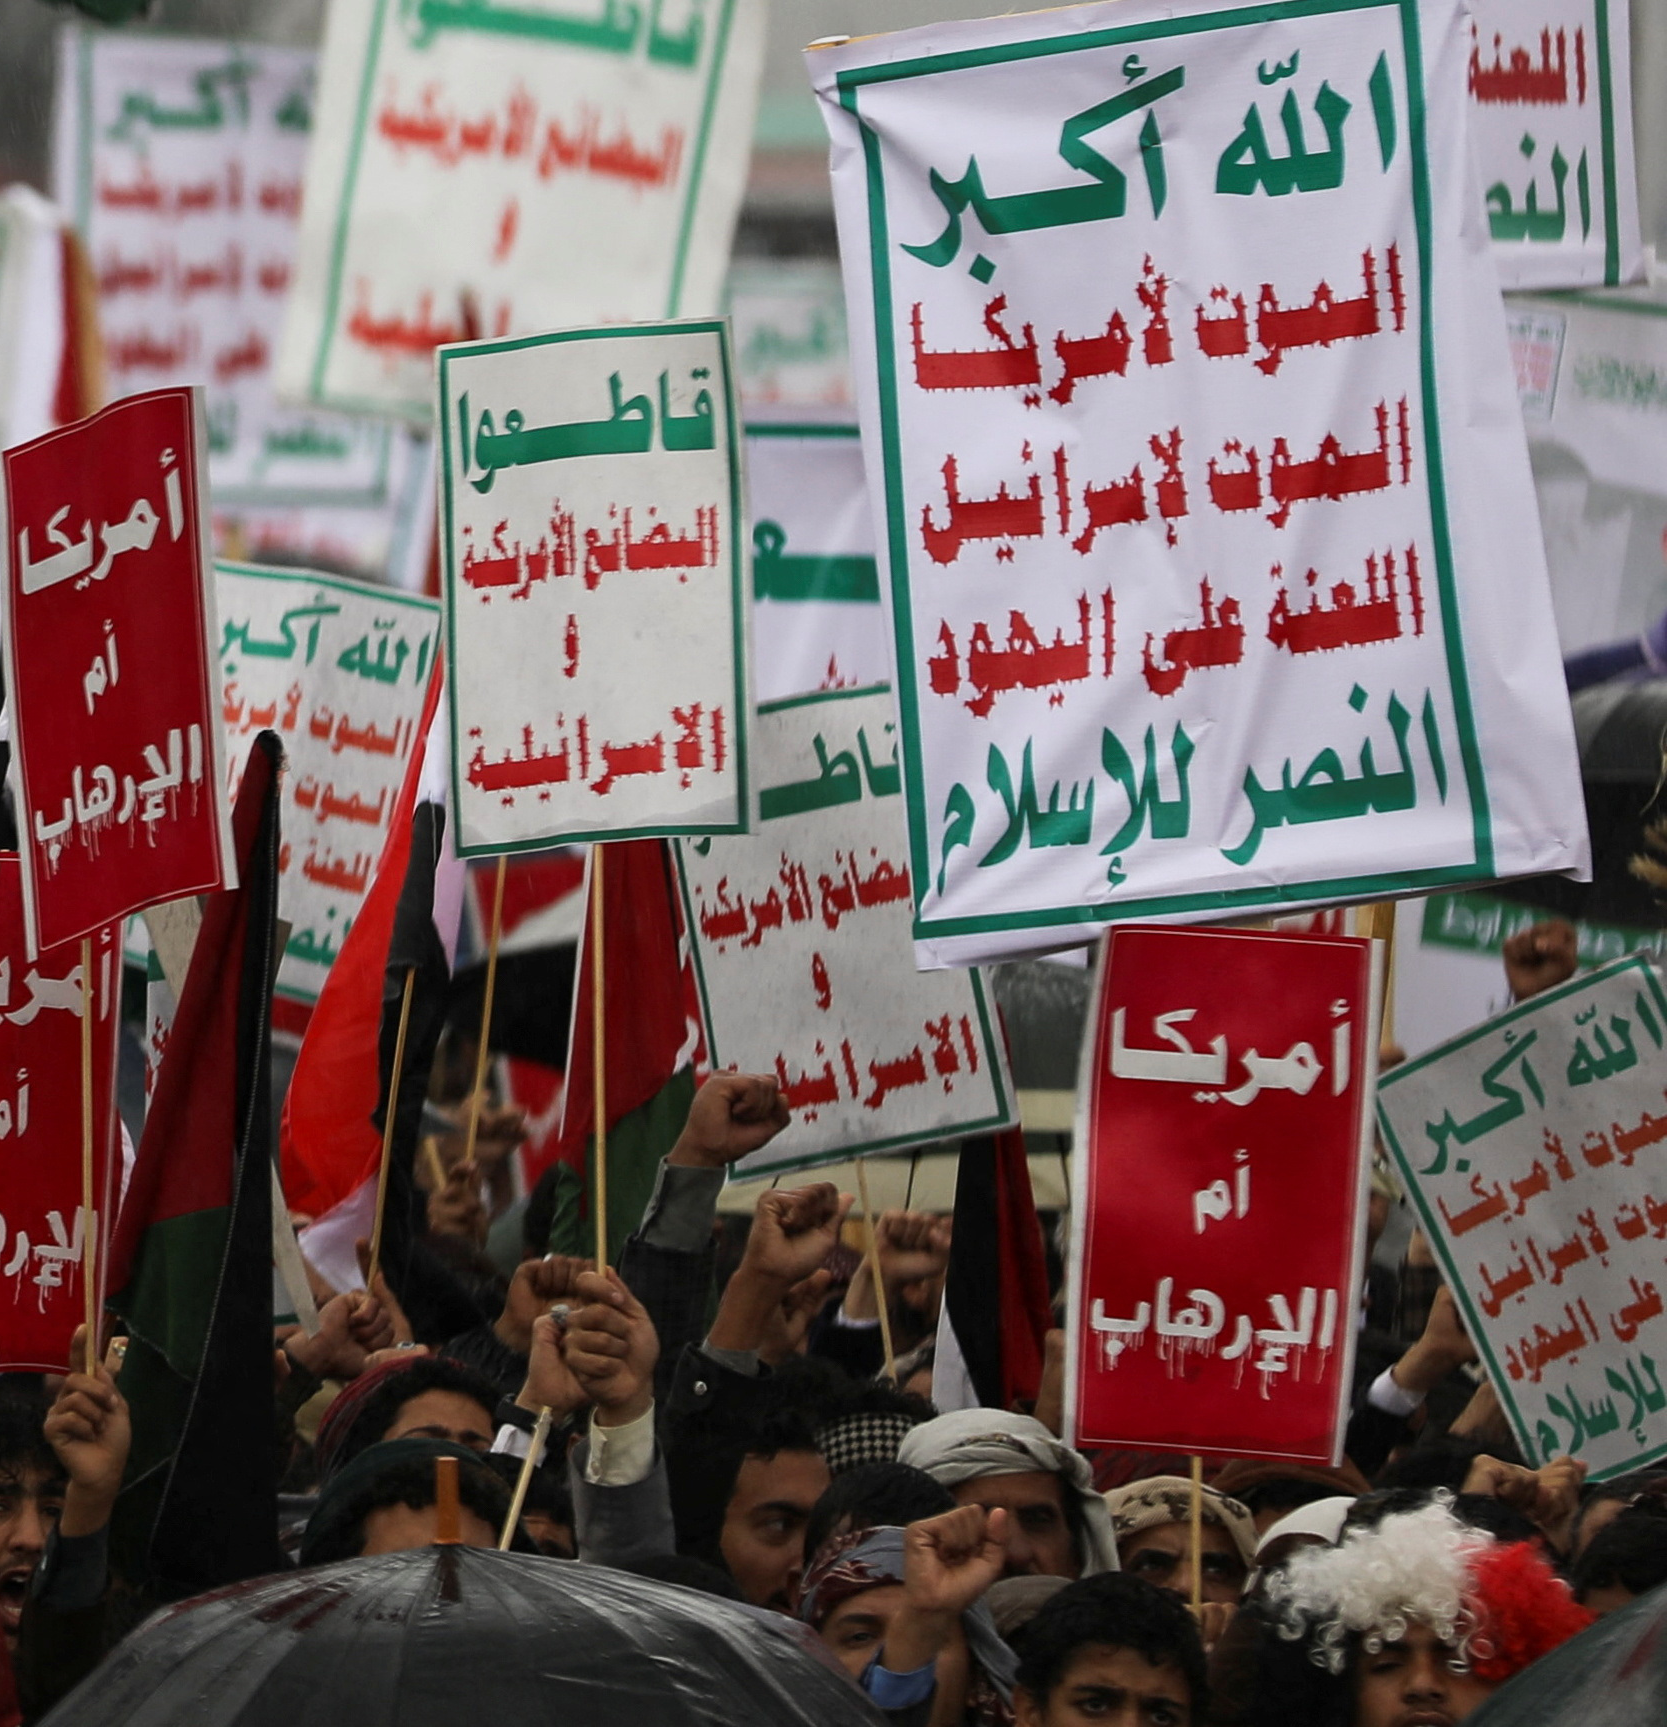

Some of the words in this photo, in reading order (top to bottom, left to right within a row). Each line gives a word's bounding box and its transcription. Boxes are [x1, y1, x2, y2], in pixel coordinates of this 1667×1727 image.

[900, 53, 1186, 285] أكبر
[1215, 52, 1397, 198] الله
[1485, 134, 1591, 242] النص
[909, 253, 1175, 408] لأمريكا
[1193, 244, 1407, 377] الموت
[457, 368, 716, 495] قاطعوا
[1206, 398, 1413, 530] الموت
[16, 446, 186, 597] أمريكا
[461, 496, 577, 603] الأمريكية
[582, 505, 720, 592] البضائع
[919, 427, 1190, 567] لإسرائيل
[337, 615, 431, 687] الله
[562, 613, 581, 680] و
[926, 587, 1117, 719] اليهود
[1140, 578, 1247, 698] على
[1265, 545, 1425, 656] اللعنة
[81, 617, 121, 717] أم
[221, 680, 303, 736] لأمريك
[309, 703, 414, 762] الموت
[465, 702, 727, 802] الإسرائيلية
[1220, 683, 1448, 867] النصر
[34, 723, 204, 857] الإرهاب
[936, 722, 1196, 895] للإسلام
[302, 836, 371, 894] للعنة
[699, 853, 814, 954] الأمريكية
[811, 952, 833, 1012] و
[775, 1013, 978, 1124] الإسرائيل
[1108, 997, 1352, 1108] أمريكا
[1566, 992, 1664, 1087] الله
[1421, 1029, 1546, 1176] أكبر
[1191, 1147, 1252, 1236] أم
[1435, 1129, 1577, 1239] لأمريكا
[1478, 1207, 1611, 1319] لإسرائيل
[1609, 1276, 1665, 1344] على
[1091, 1275, 1339, 1380] الإرهاب
[1504, 1294, 1601, 1384] اليهود
[1535, 1354, 1667, 1463] للإسلام
